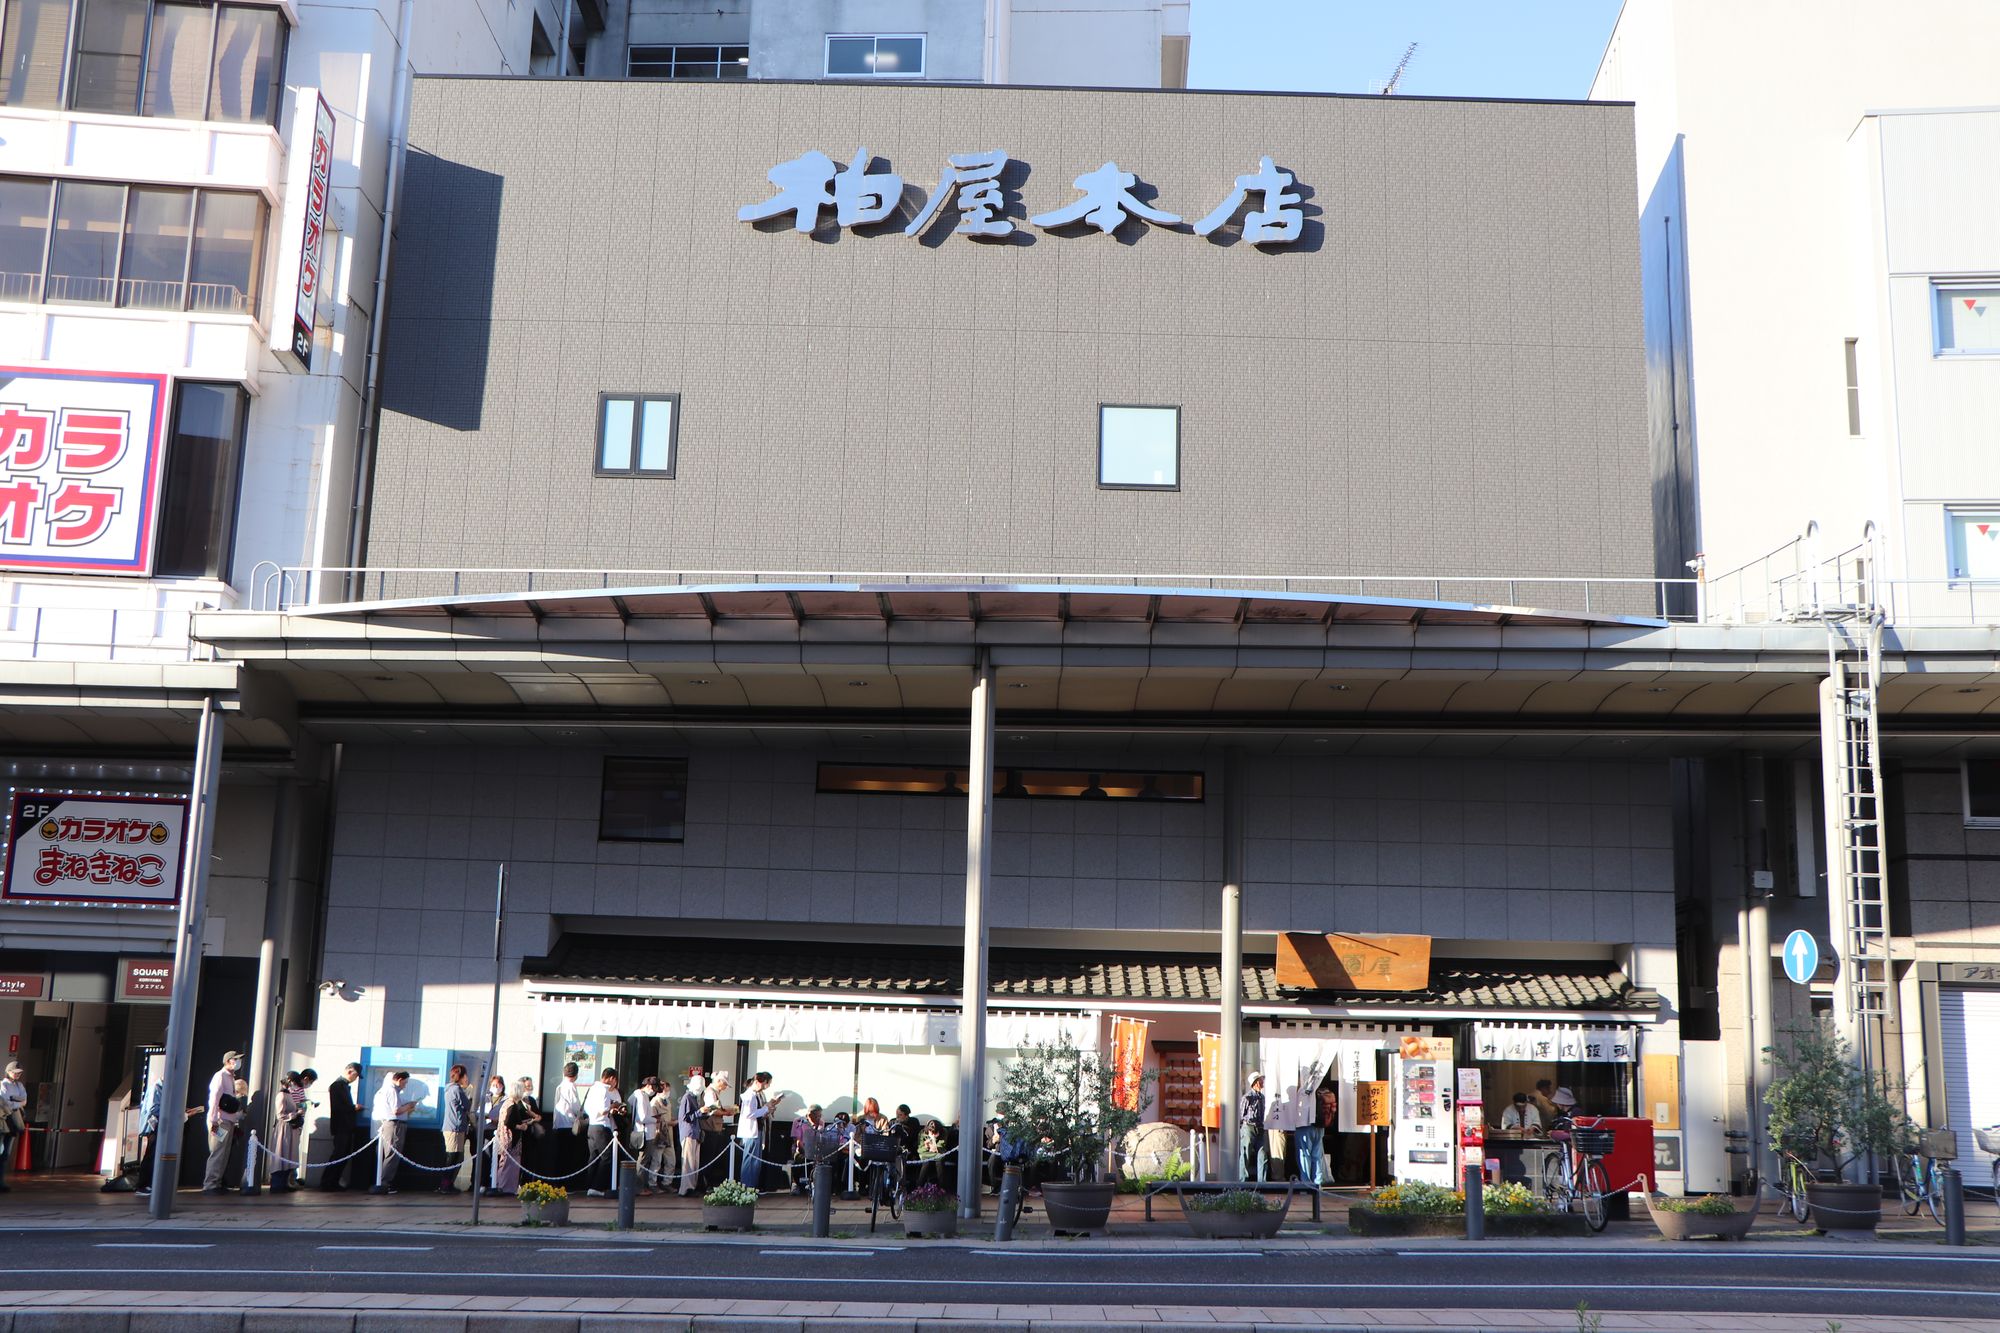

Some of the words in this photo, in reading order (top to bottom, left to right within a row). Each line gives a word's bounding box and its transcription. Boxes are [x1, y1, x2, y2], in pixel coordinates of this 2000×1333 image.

[301, 127, 329, 298] カラオケ
[737, 146, 1305, 246] 柏屋本店
[296, 331, 310, 357] 2F
[0, 404, 130, 474] カラ
[0, 476, 123, 546] オケ
[22, 804, 50, 818] 2F
[58, 817, 152, 844] カラオケ
[34, 846, 166, 887] まねきねこ
[133, 968, 169, 977] SQUARE
[1964, 966, 2000, 980] アオ
